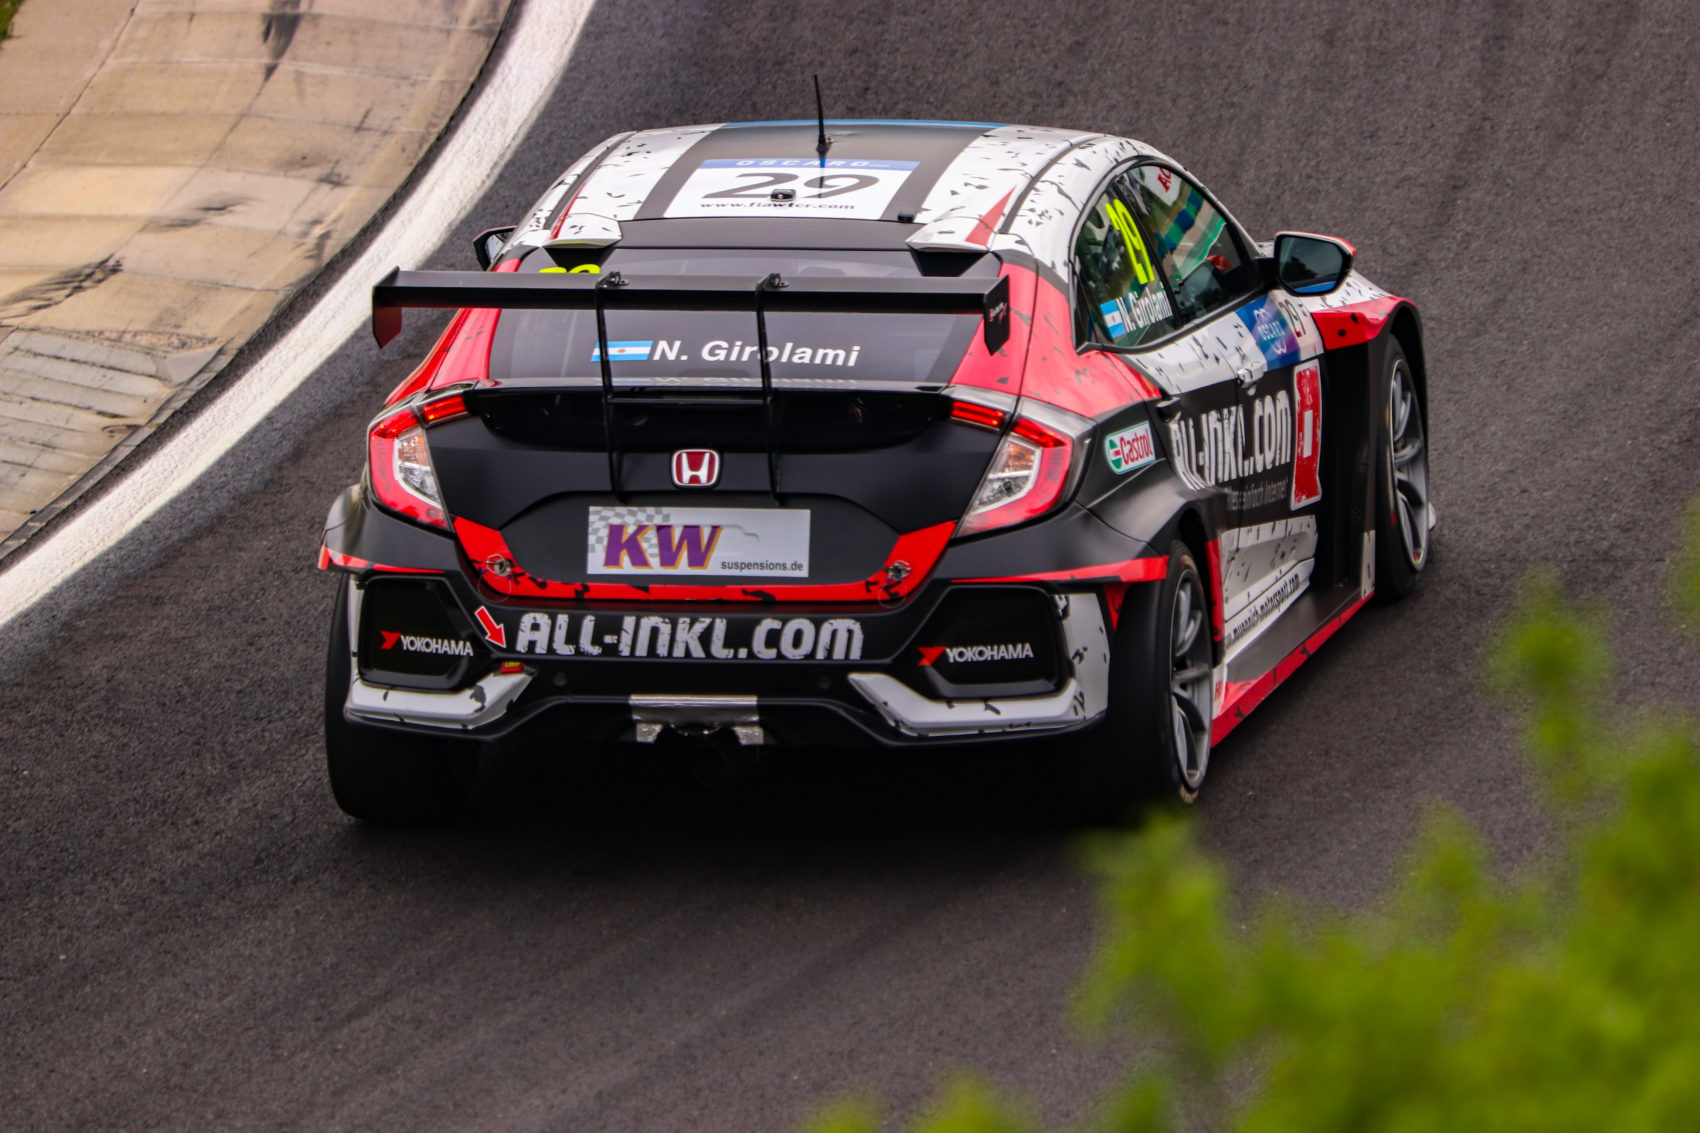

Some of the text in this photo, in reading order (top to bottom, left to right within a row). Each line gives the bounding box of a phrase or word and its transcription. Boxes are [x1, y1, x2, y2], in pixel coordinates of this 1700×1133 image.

[702, 172, 880, 199] 29
[700, 201, 856, 210] www.fiawtcr.com
[1128, 281, 1173, 329] Girolami
[653, 340, 861, 367] N. Girolami
[1120, 428, 1153, 465] Castrol
[603, 524, 723, 570] KW
[721, 560, 804, 572] suspensions.de
[401, 634, 474, 656] YOKOHAMA
[945, 642, 1034, 663] YOKOHAMA
